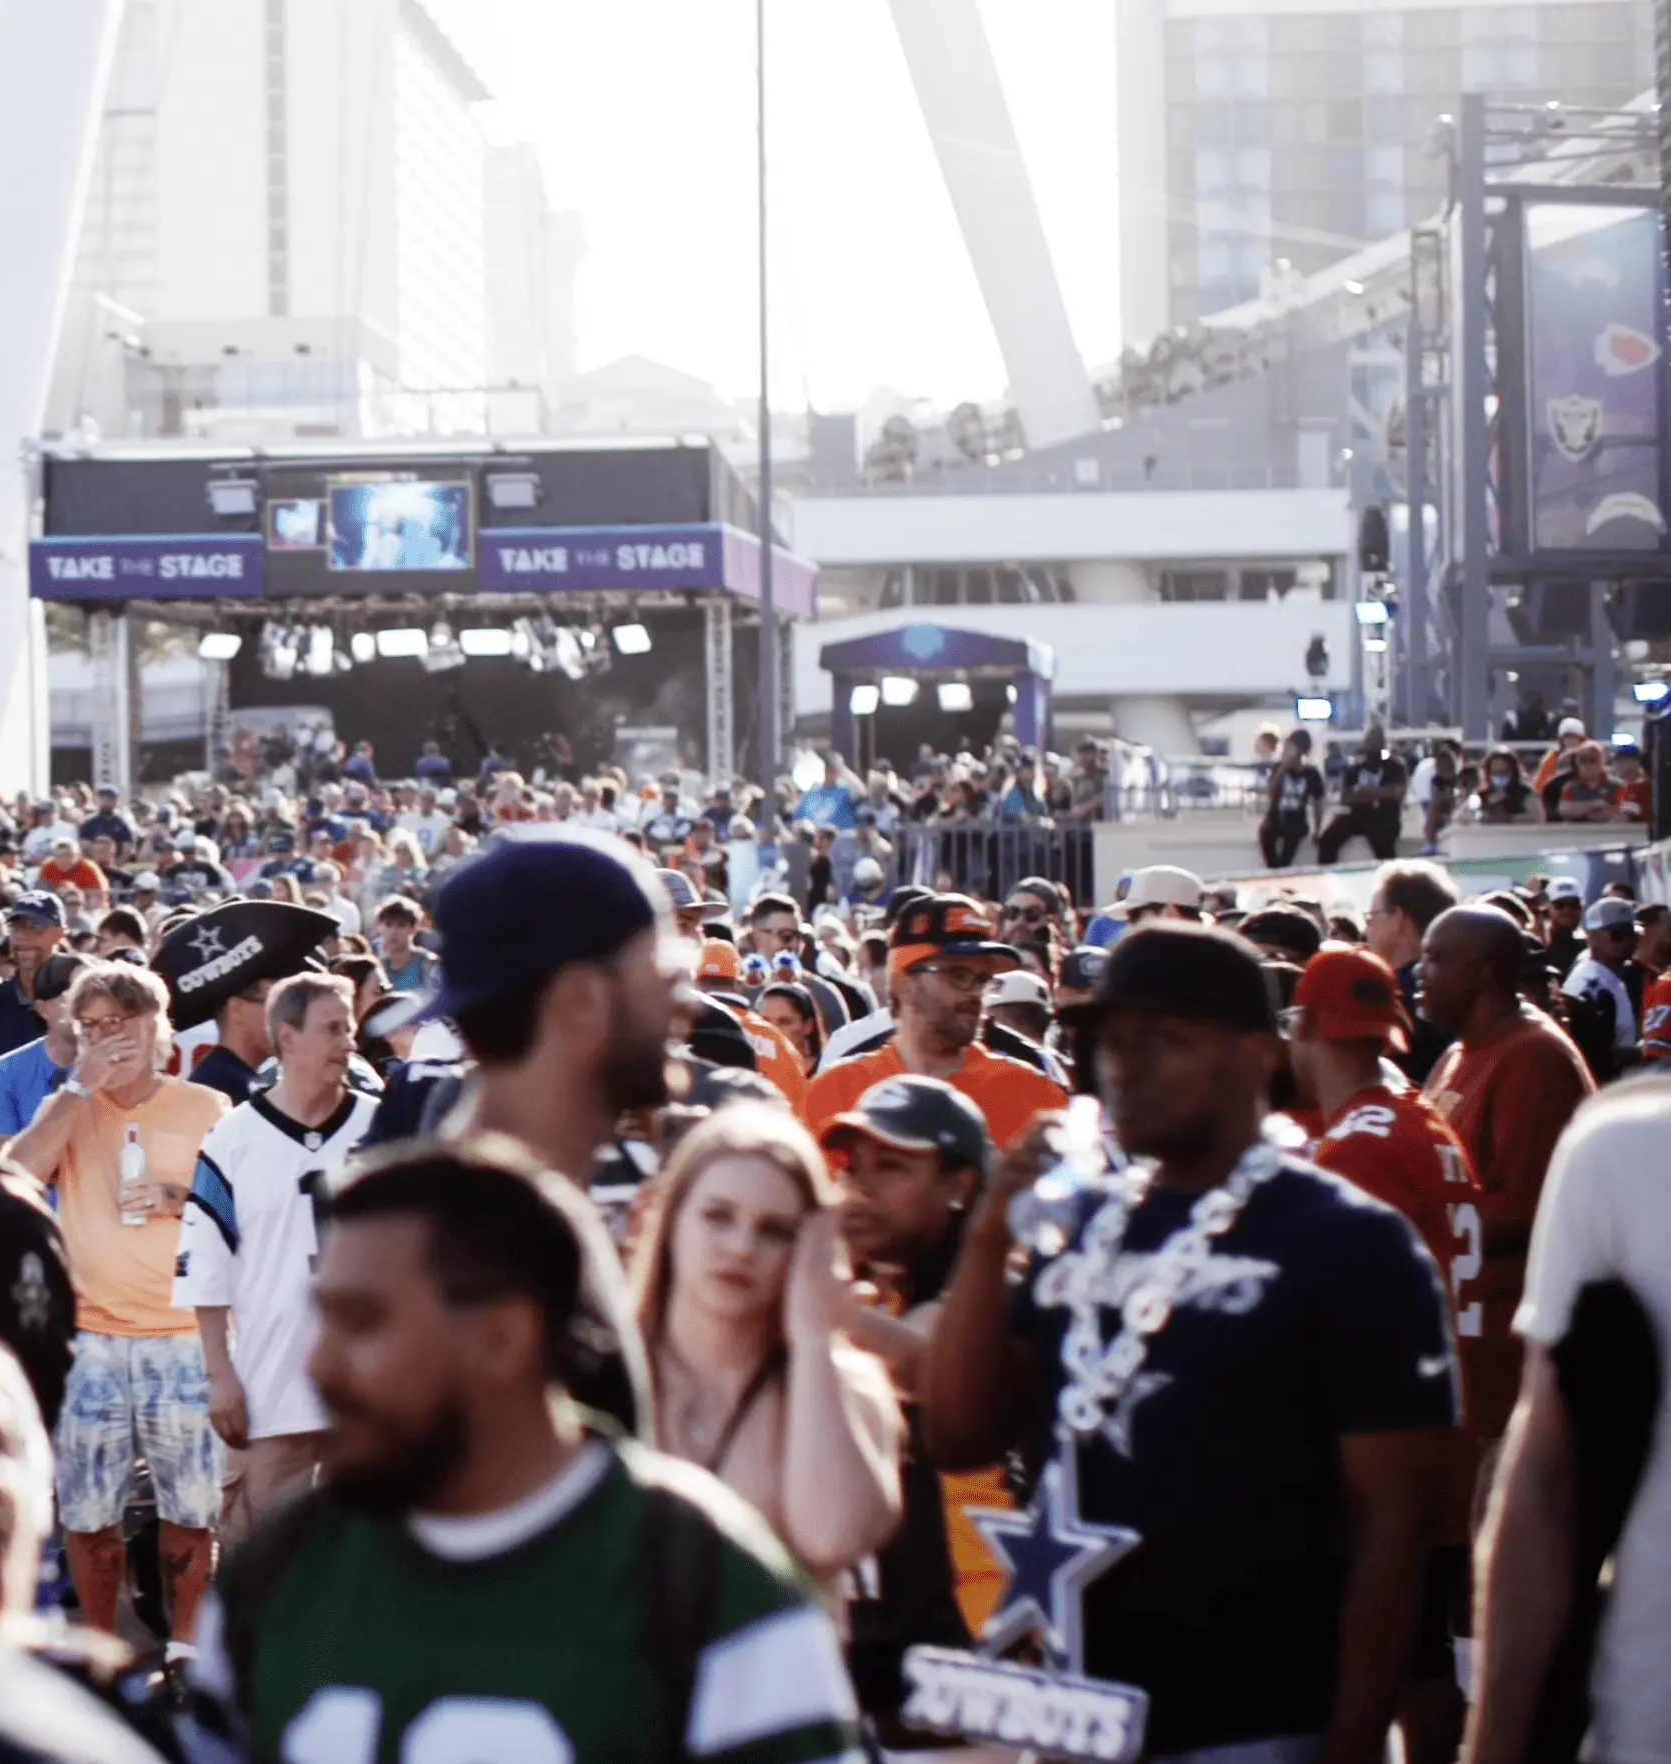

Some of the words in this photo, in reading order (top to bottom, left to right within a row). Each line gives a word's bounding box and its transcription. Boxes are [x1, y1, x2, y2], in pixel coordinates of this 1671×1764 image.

[47, 555, 115, 580] TAKE
[159, 553, 243, 579] STAGE
[498, 546, 568, 573] TAKE
[616, 542, 704, 571] STAGE
[177, 934, 264, 993] COWBOYS
